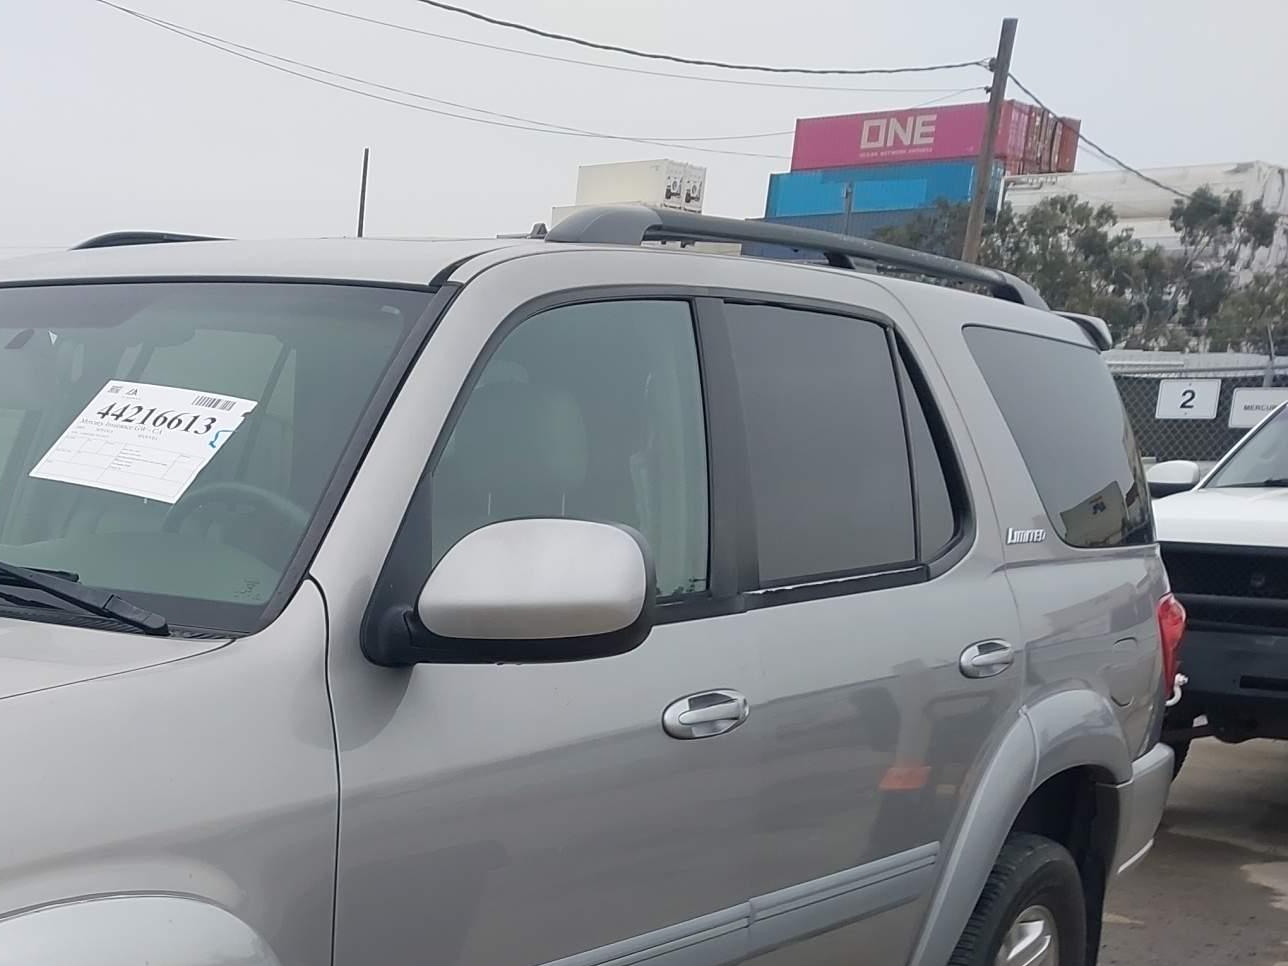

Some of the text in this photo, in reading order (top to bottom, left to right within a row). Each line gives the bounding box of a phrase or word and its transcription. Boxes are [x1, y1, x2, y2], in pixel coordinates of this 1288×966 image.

[860, 114, 937, 150] ONE
[1179, 389, 1196, 409] 2
[96, 402, 217, 435] 44216613
